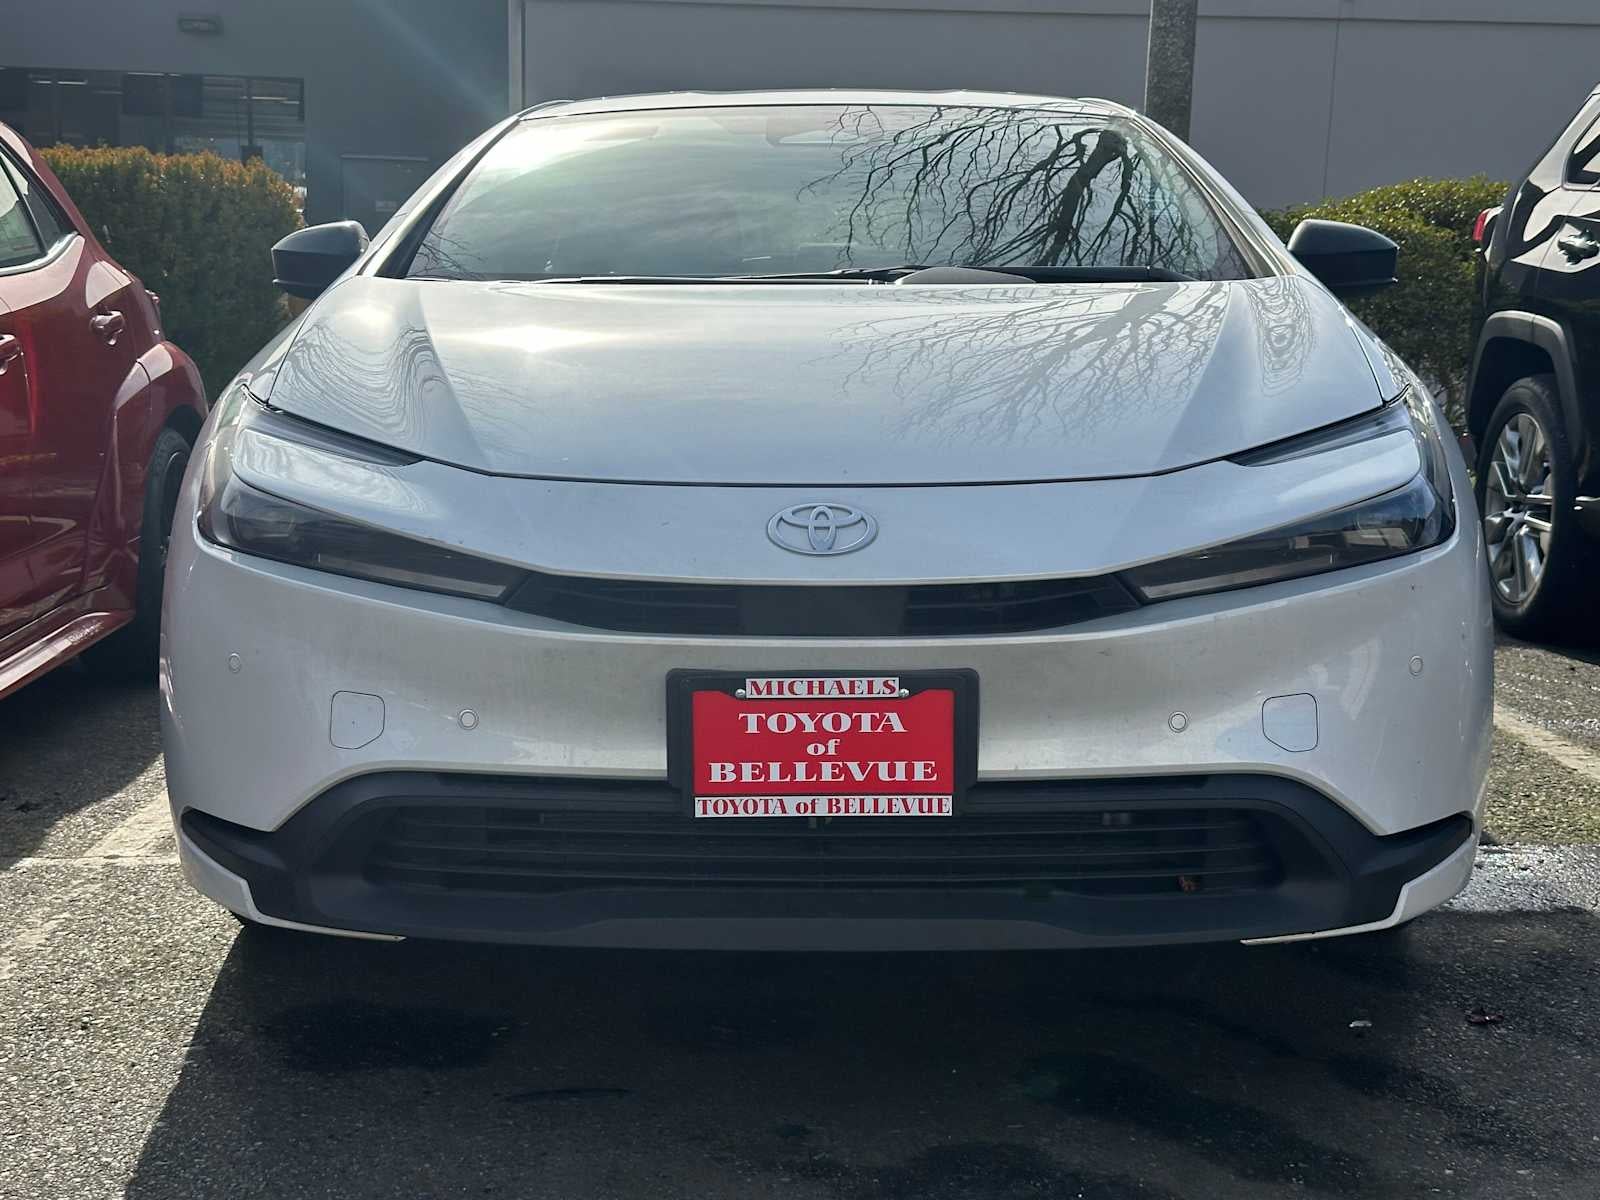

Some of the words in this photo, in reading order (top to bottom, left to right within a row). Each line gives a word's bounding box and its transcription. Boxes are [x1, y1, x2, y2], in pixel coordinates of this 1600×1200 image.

[749, 679, 897, 697] MICHAELS
[738, 712, 908, 734] TOYOTA
[806, 738, 841, 756] of
[708, 760, 938, 783] BELLEVUE
[697, 798, 788, 815] TOYOTA
[795, 798, 817, 815] of
[827, 797, 952, 815] BELLEVUE
